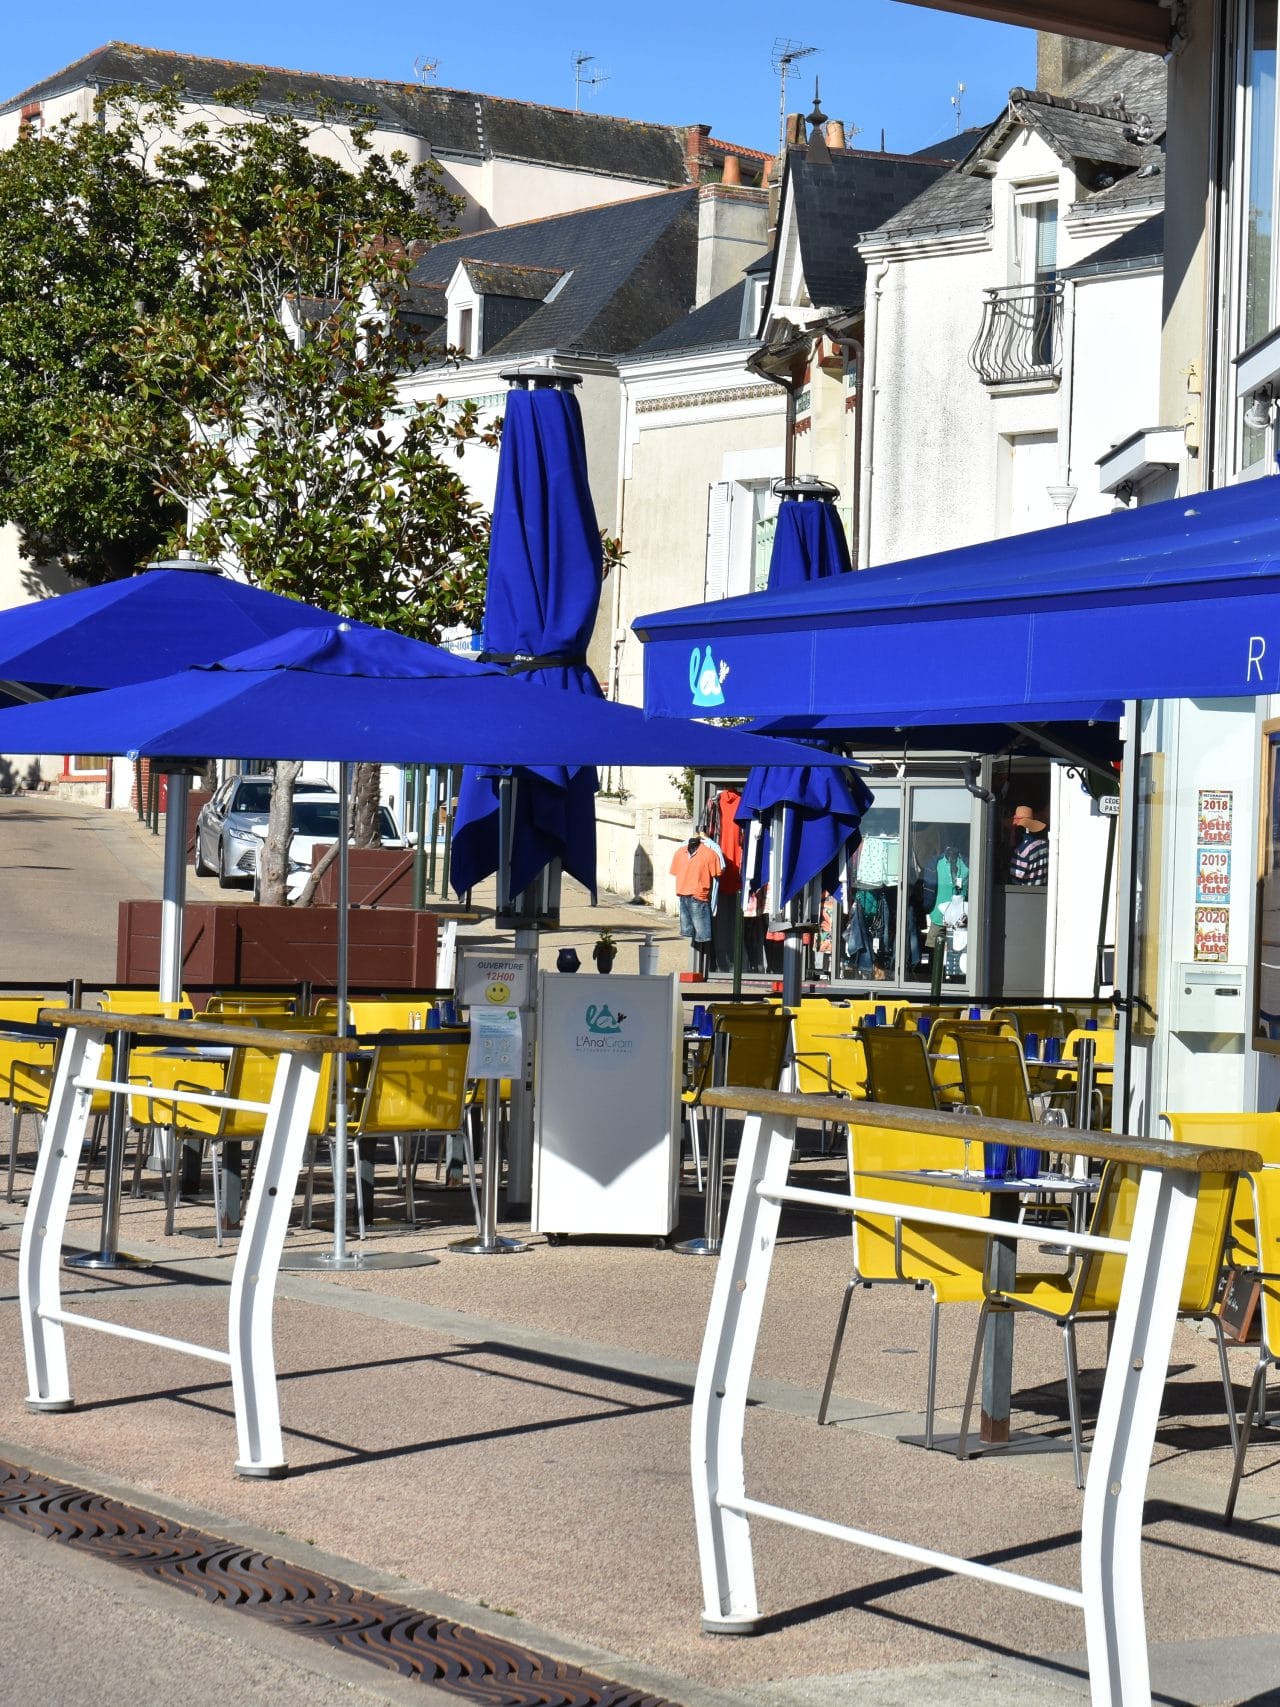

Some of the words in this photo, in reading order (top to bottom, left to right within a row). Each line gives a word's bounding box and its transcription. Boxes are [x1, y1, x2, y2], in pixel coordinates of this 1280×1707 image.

[1203, 800, 1228, 810] 2018
[1199, 820, 1231, 832] petit
[1201, 854, 1227, 866] 2019
[1197, 874, 1229, 886] petit
[1198, 911, 1227, 923] 2020
[1195, 933, 1228, 944] petit
[477, 961, 525, 971] OUVERTURE
[486, 972, 515, 981] 12H00
